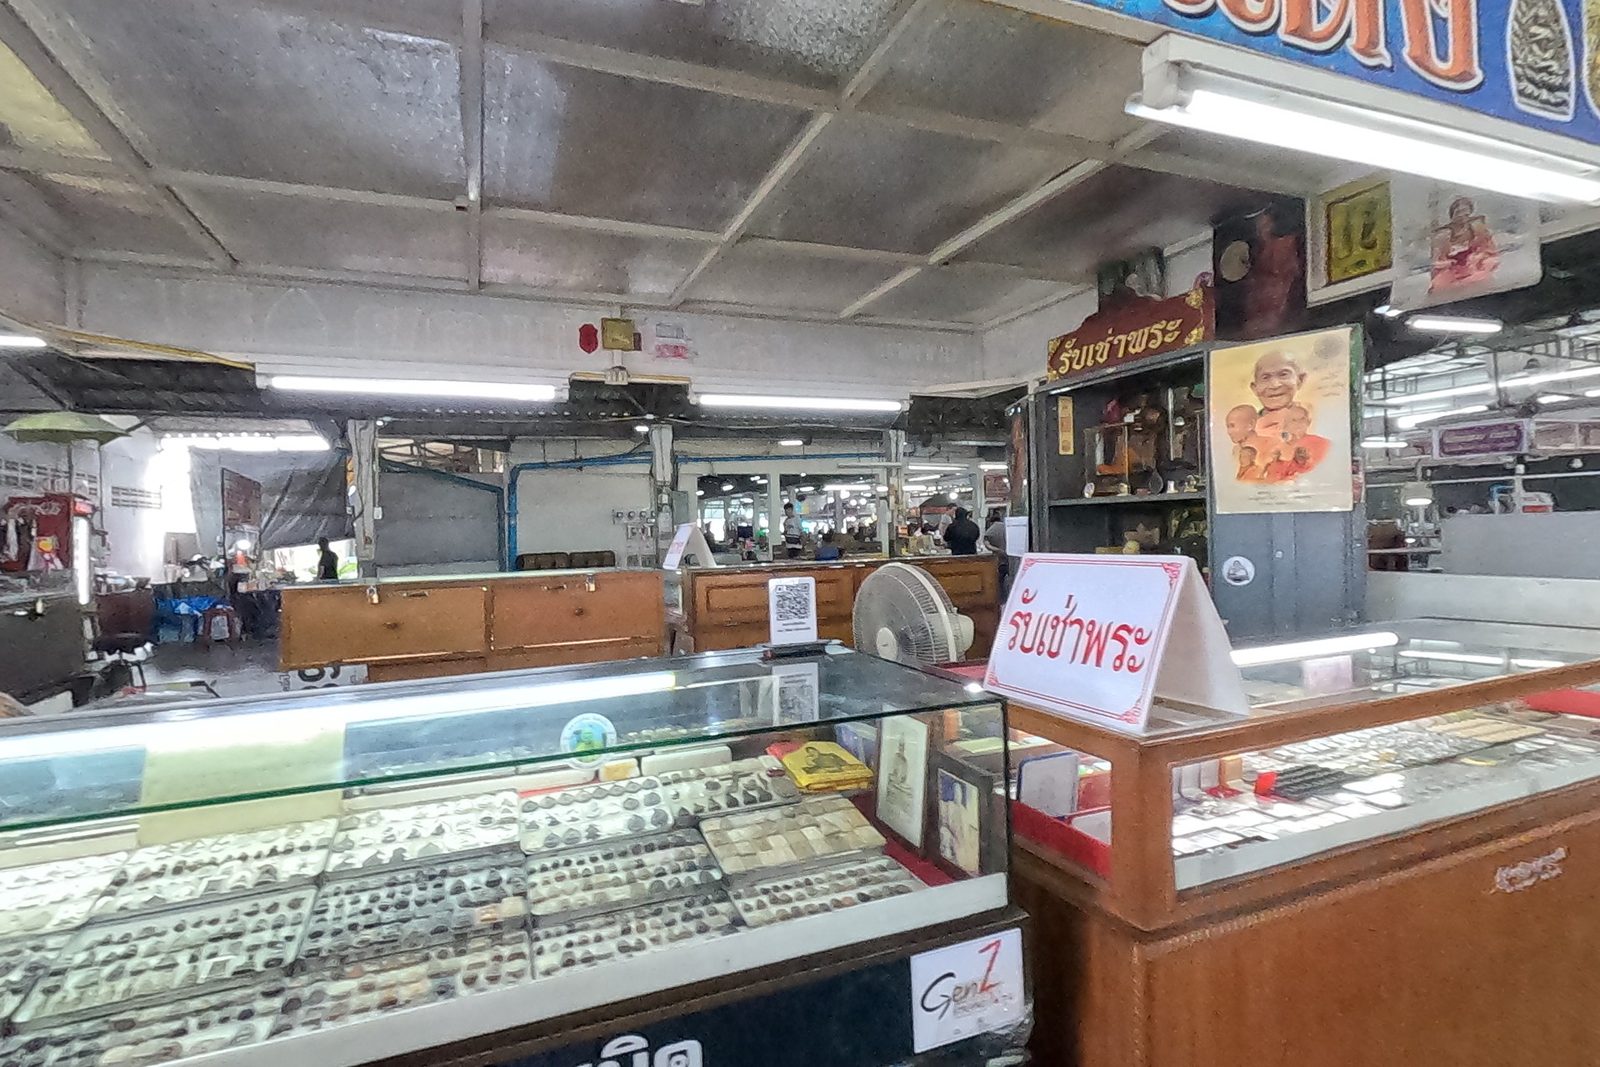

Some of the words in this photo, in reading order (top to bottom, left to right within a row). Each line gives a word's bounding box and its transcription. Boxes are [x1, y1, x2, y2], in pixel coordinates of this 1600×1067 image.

[1058, 318, 1183, 374] รับเช่าพระ
[1008, 588, 1152, 673] รับเช่าพระ
